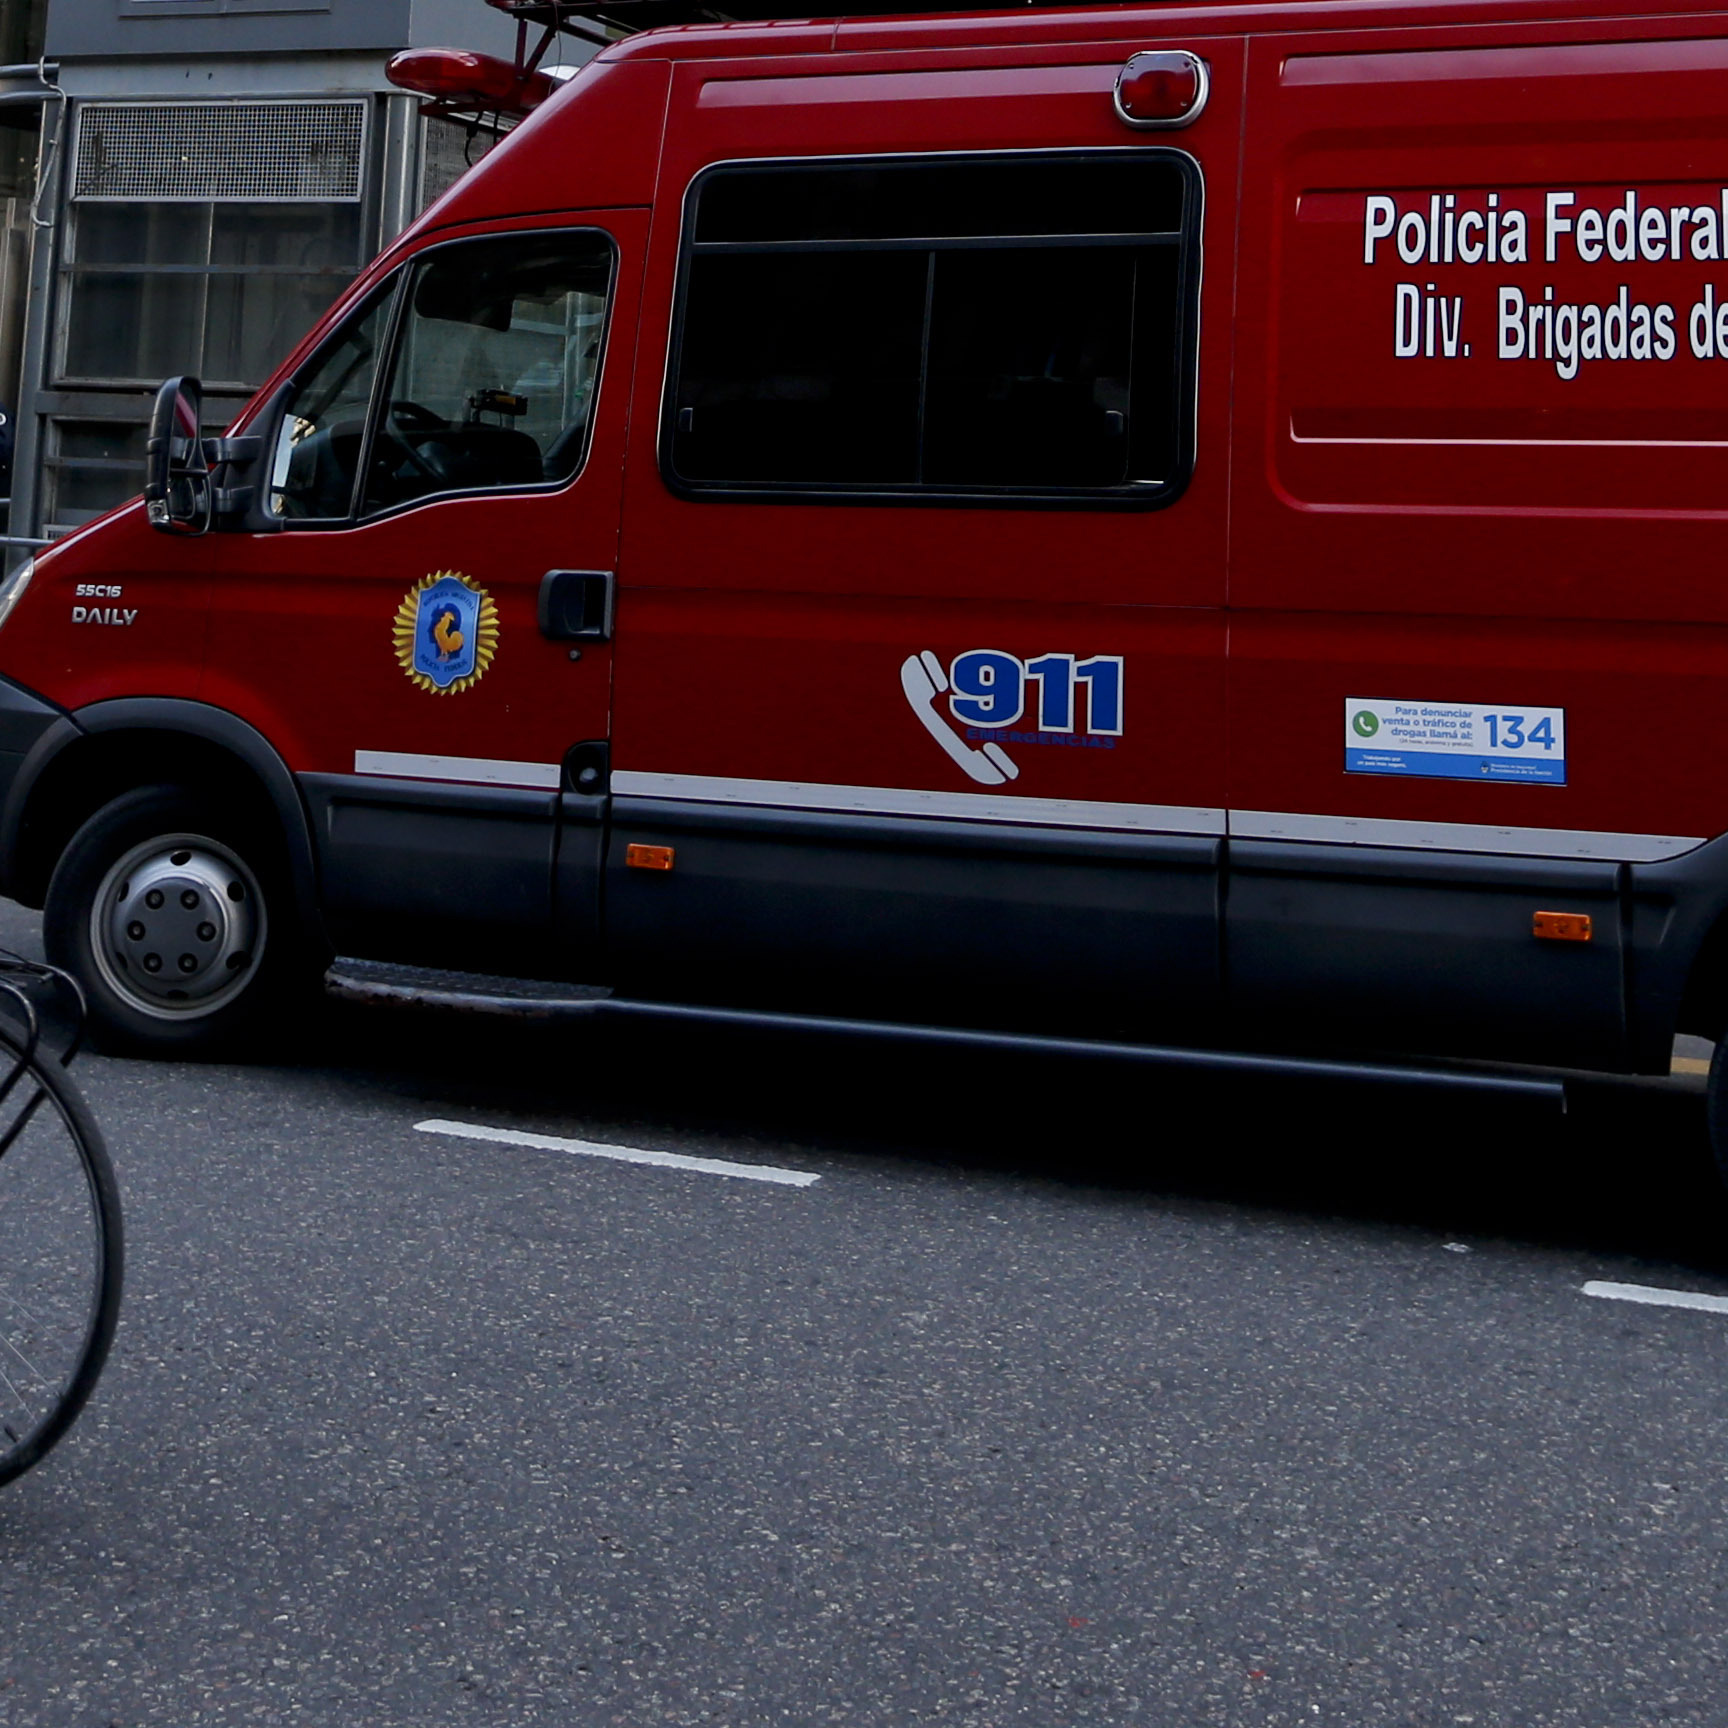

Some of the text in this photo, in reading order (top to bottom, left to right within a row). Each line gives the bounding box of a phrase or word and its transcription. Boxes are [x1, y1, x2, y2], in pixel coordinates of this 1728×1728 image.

[1363, 193, 1528, 265] Policia
[1394, 282, 1471, 359] Div.
[1498, 285, 1676, 380] Brigadas
[75, 584, 122, 598] 55C16
[72, 606, 139, 626] DAILY
[949, 649, 1124, 736] 911
[1395, 706, 1473, 718] Para denunciar
[1382, 717, 1410, 726] venta
[1422, 718, 1457, 729] tráfico
[1459, 720, 1472, 729] de
[1391, 727, 1427, 738] drogas
[1429, 728, 1458, 739] llamá
[1483, 714, 1556, 750] 134
[966, 728, 1115, 749] EMERGENCIAS
